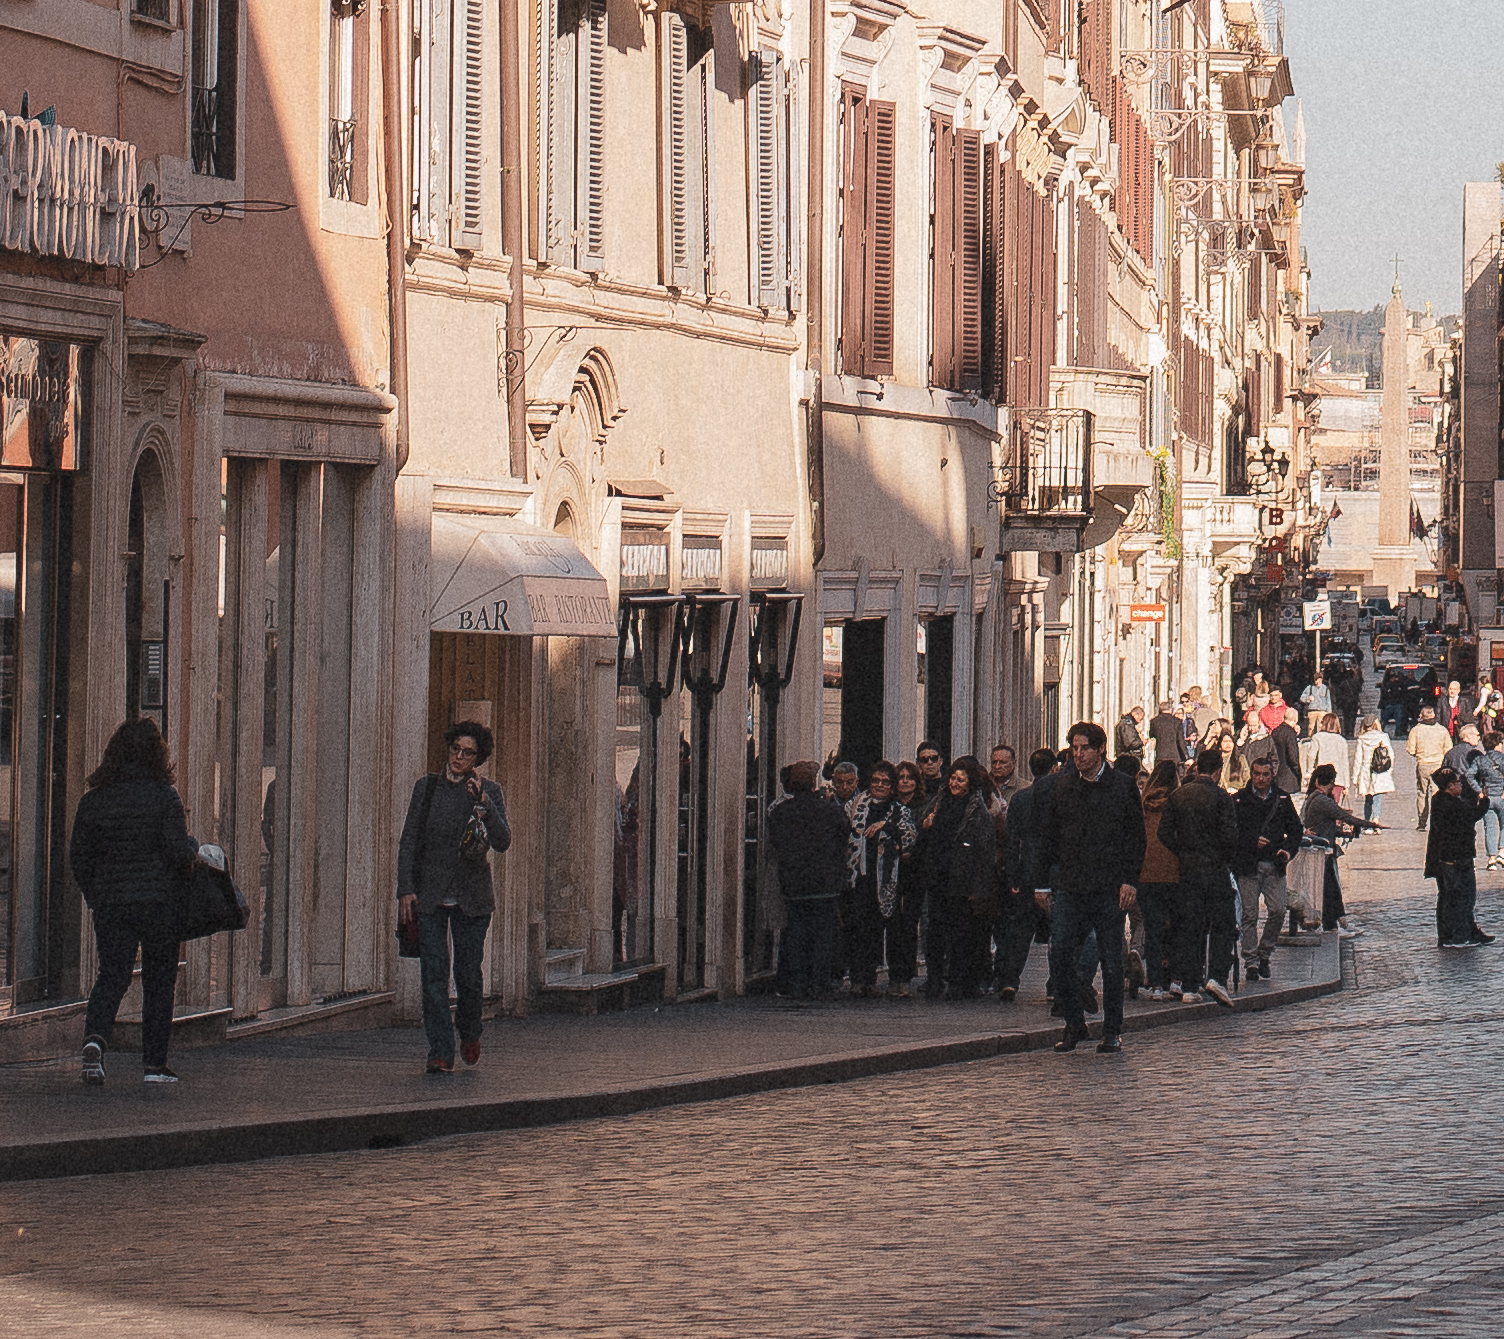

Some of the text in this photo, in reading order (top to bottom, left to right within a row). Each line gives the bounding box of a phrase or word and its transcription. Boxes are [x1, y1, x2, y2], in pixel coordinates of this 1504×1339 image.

[457, 599, 511, 632] BAR
[527, 594, 615, 625] BAR RISTORANTE
[1132, 608, 1165, 621] change
